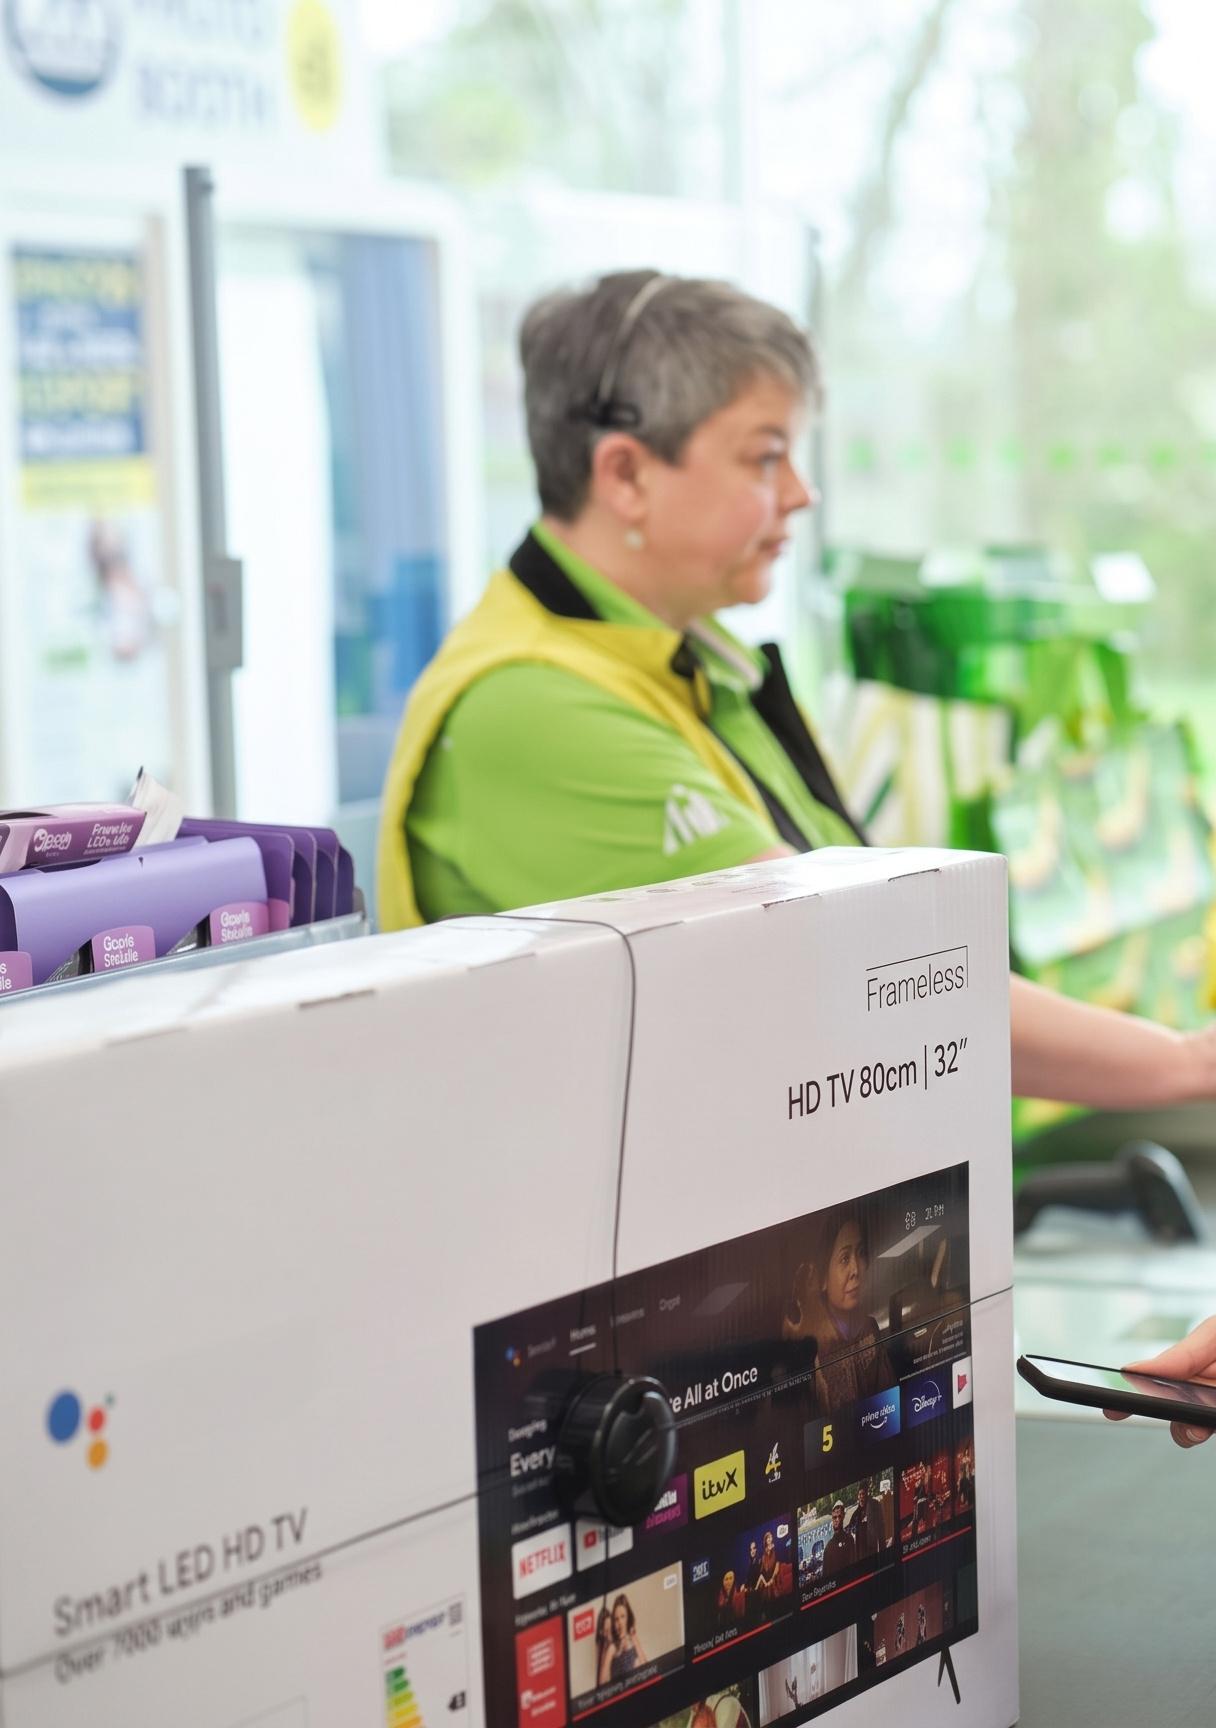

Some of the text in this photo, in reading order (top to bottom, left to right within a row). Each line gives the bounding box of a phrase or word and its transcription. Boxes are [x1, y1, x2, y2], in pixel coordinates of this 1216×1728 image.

[866, 963, 965, 1011] Frameless
[788, 1080, 821, 1120] HD
[826, 1069, 855, 1108] TV
[859, 1060, 917, 1098] 80cm
[510, 1444, 556, 1478] Every
[683, 1382, 702, 1410] All
[704, 1378, 719, 1401] at
[721, 1367, 758, 1393] Once
[822, 1424, 834, 1452] 5
[701, 1468, 739, 1501] itvX
[53, 1507, 307, 1638] Smart LED HD TV
[518, 1540, 567, 1579] NETFLIX
[54, 1645, 104, 1685] Over
[219, 1581, 256, 1619] and
[258, 1561, 323, 1609] games
